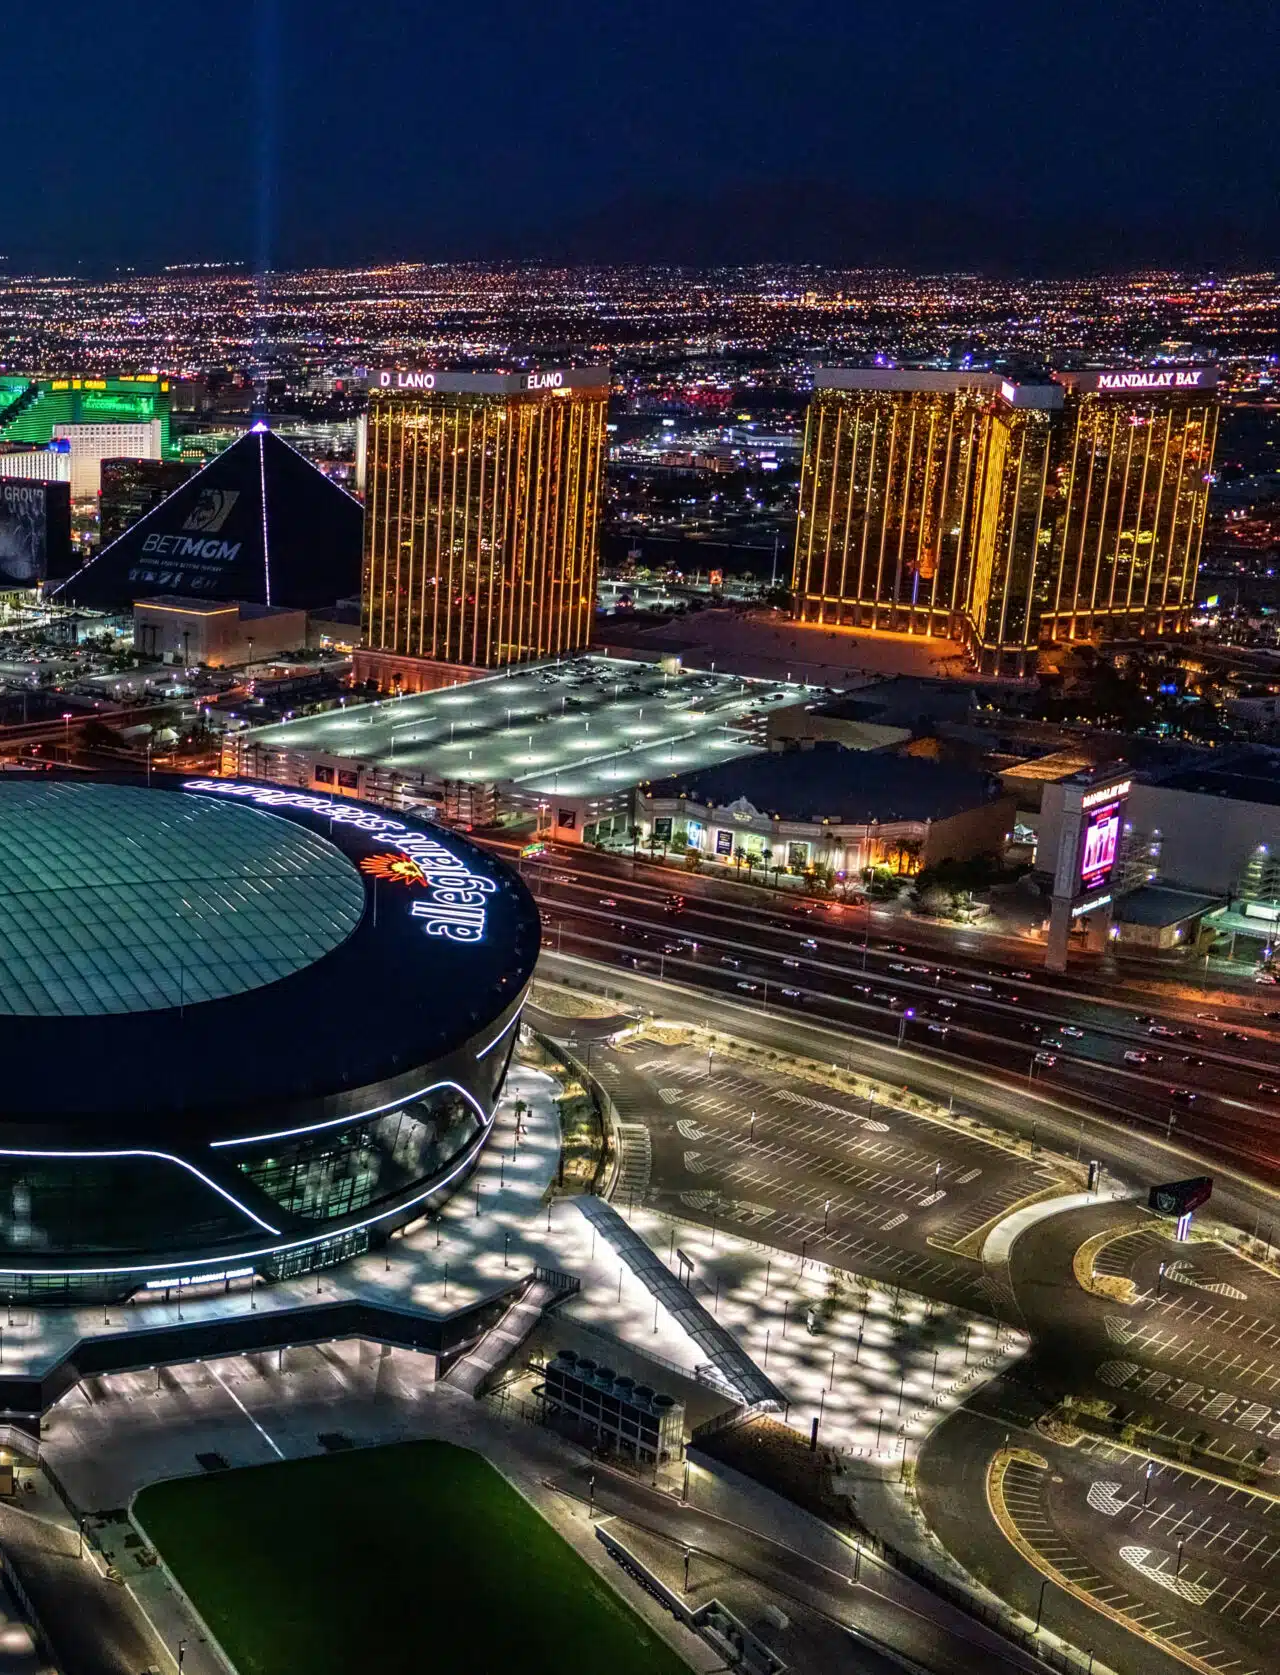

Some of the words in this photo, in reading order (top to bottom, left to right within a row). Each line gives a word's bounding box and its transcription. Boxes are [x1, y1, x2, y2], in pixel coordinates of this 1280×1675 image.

[84, 380, 107, 389] GRAND
[1097, 372, 1175, 389] MANDALAY
[1175, 371, 1202, 386] BAY
[142, 533, 243, 561] BETMGM
[183, 780, 406, 831] stadium
[372, 831, 497, 942] allegiant
[180, 1276, 191, 1285] TO
